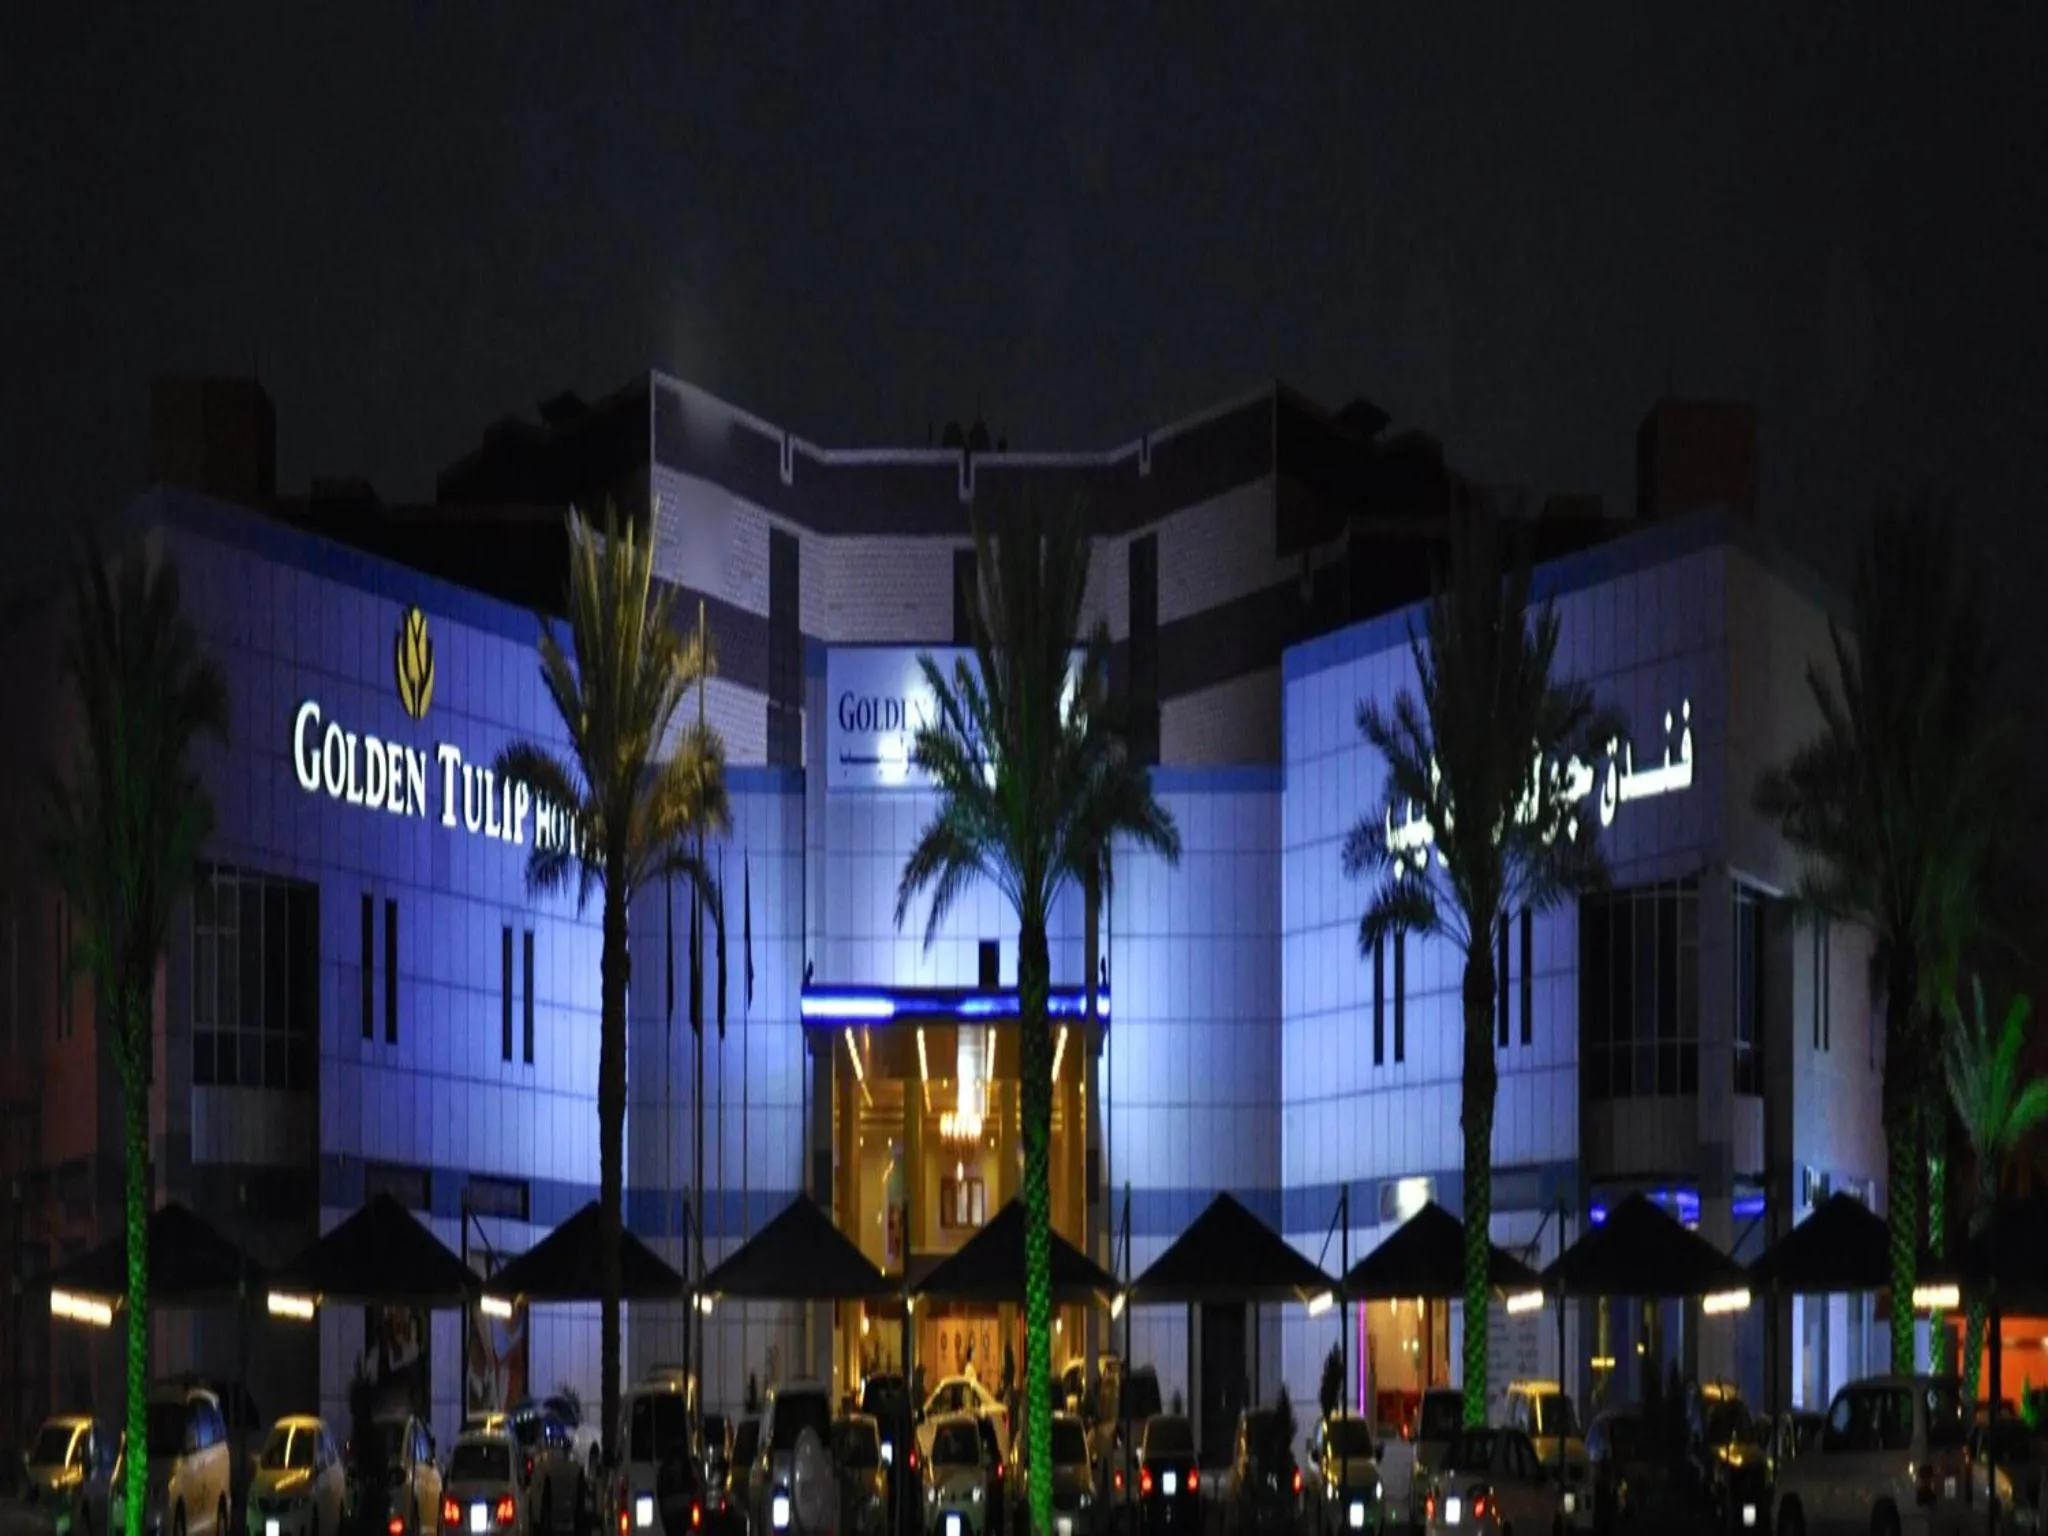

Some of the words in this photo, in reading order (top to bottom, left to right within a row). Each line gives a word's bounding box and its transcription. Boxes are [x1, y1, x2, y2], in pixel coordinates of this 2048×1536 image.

[294, 700, 427, 820] GOLDEN
[437, 743, 530, 846] TULIP
[535, 788, 607, 866] HOT
[1600, 698, 1693, 829] فندق
